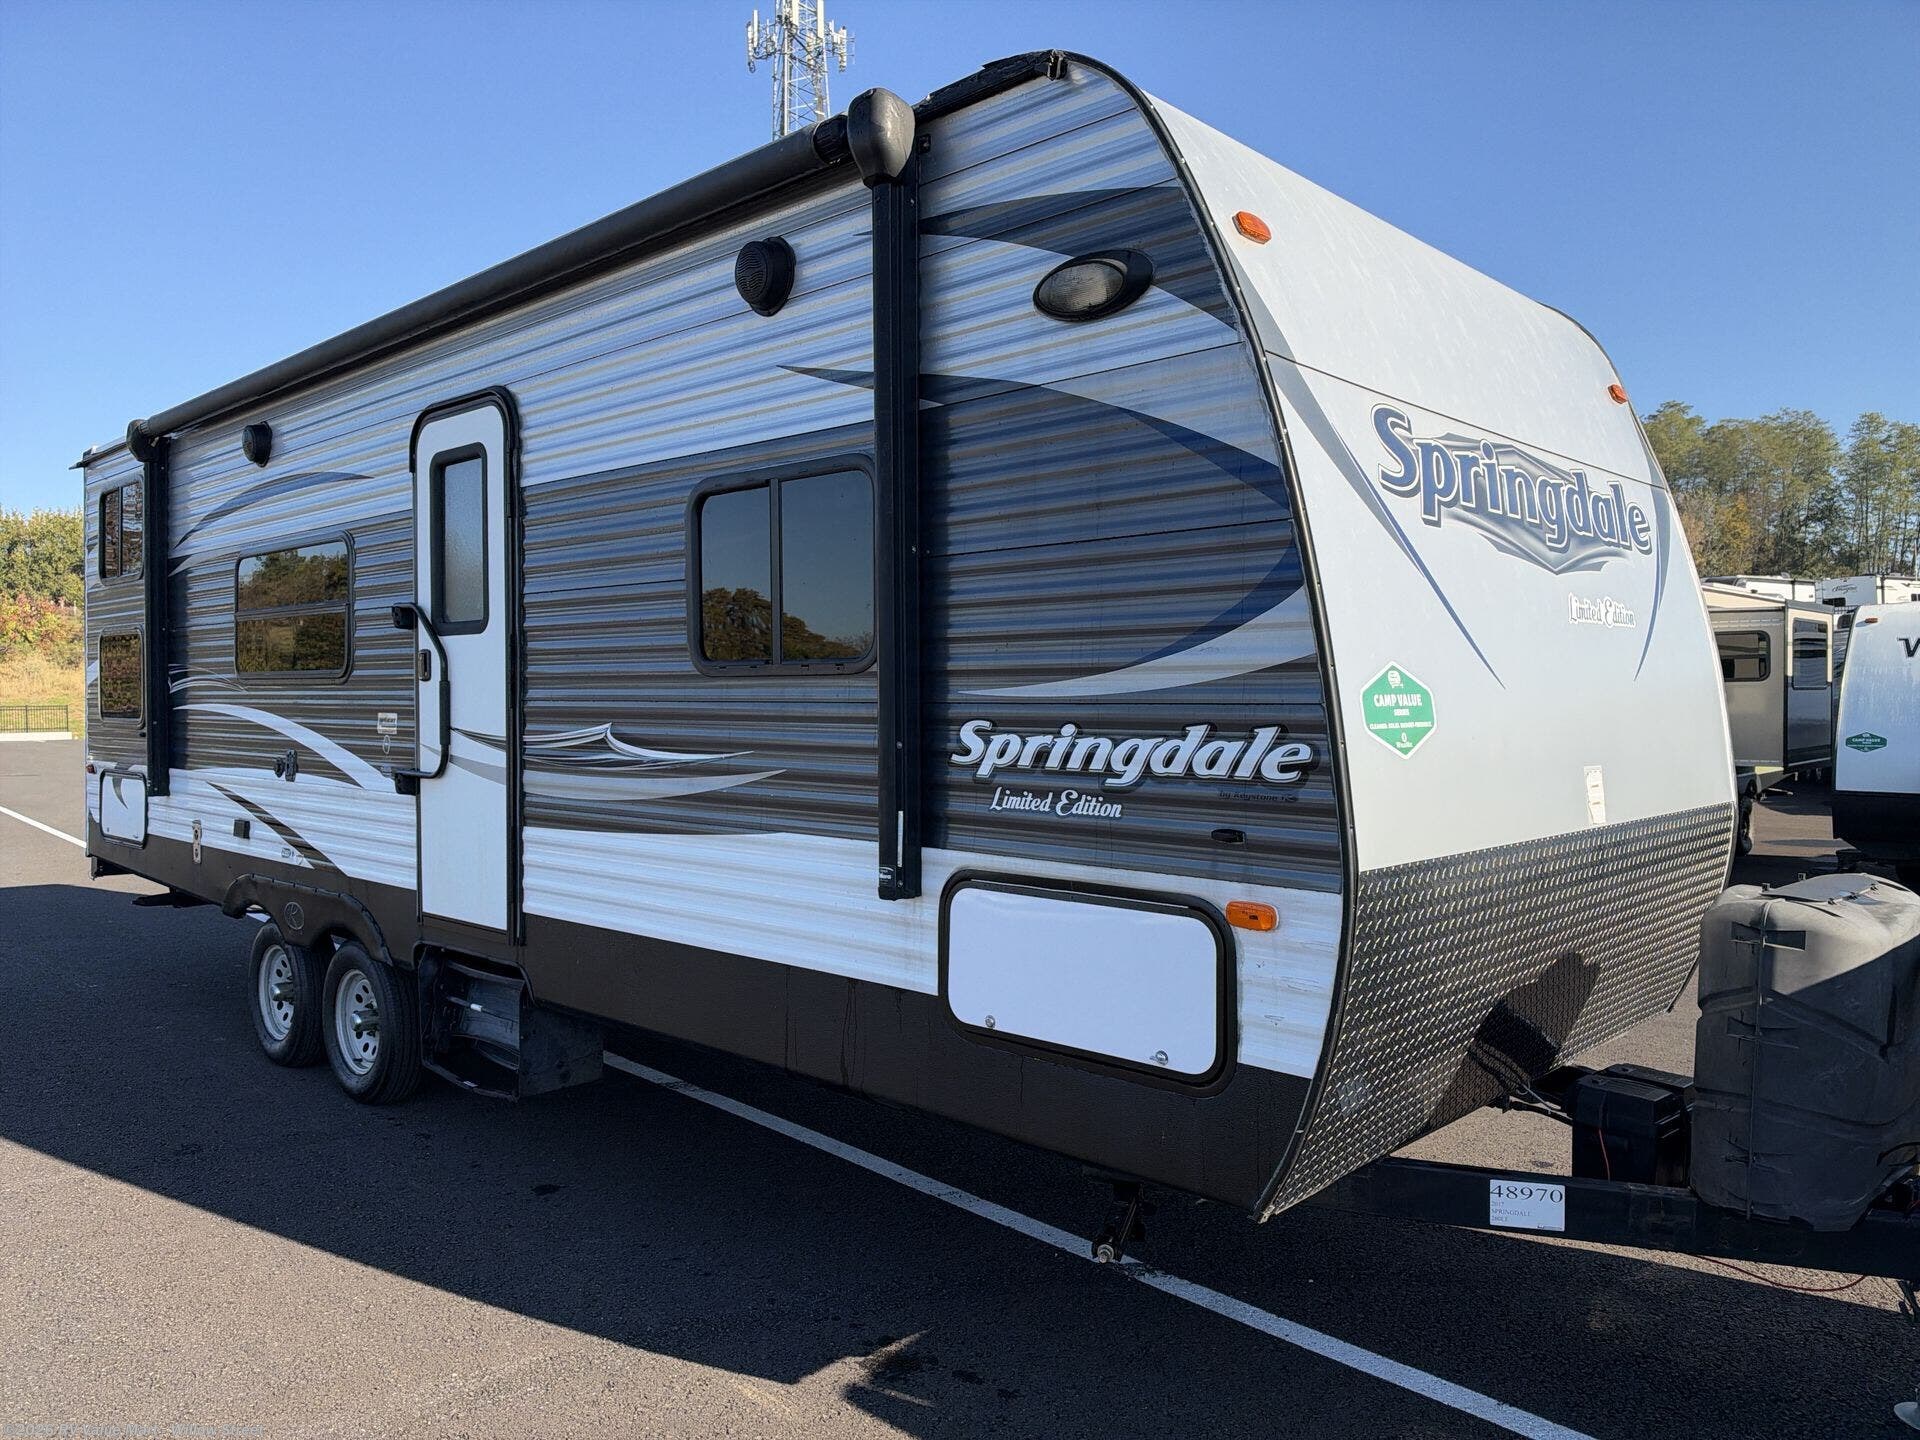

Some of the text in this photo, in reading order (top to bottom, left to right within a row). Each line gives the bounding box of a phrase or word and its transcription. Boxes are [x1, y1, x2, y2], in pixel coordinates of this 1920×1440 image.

[1371, 403, 1652, 555] Springdale
[1569, 593, 1636, 628] Limited Edition
[1373, 693, 1423, 707] CAMP VALUE
[949, 718, 1315, 788] Springdale
[989, 786, 1123, 818] Limited Edition
[1490, 1185, 1563, 1203] 48970
